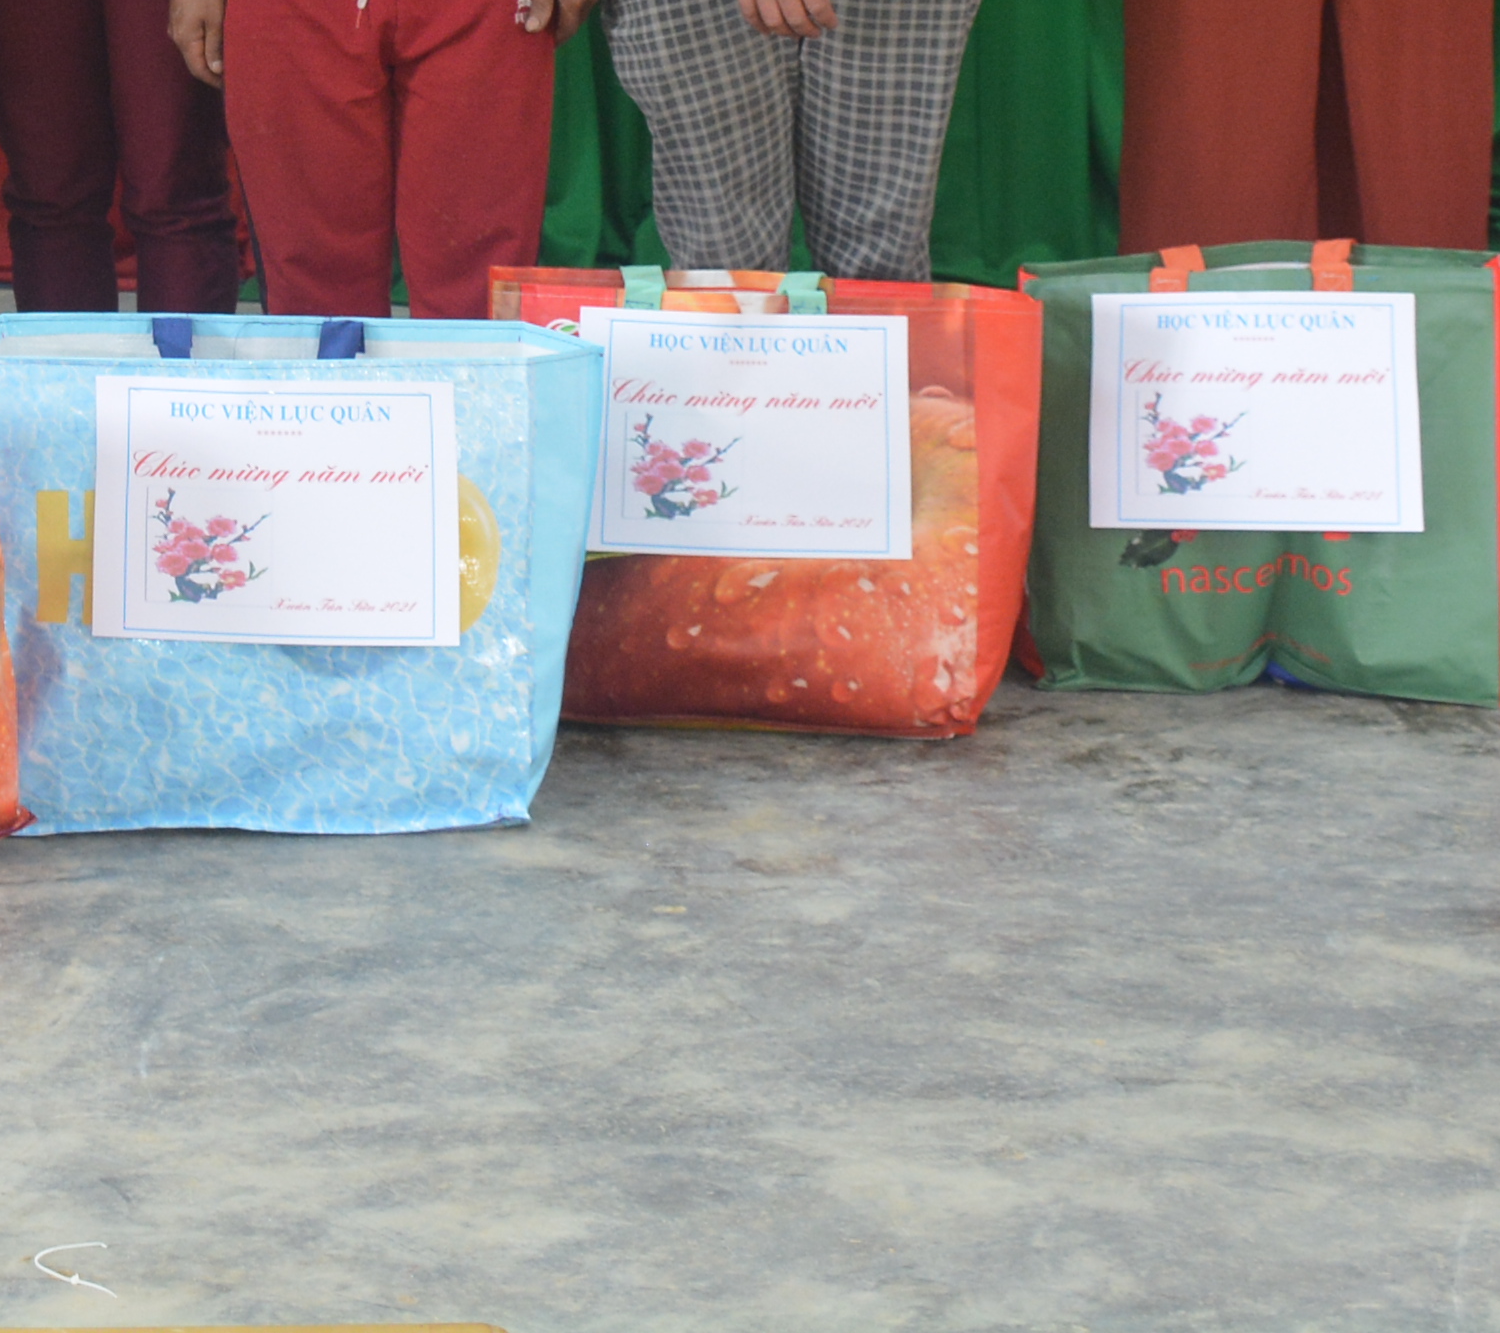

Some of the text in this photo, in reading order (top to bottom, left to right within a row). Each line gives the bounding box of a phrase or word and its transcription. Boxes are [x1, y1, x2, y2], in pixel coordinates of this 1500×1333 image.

[650, 334, 694, 351] HỌC
[700, 334, 744, 354] VIỆN
[170, 401, 391, 425] HỌC VIỆN LỤC QUÂN
[133, 451, 200, 479] Chúc
[298, 465, 360, 482] năm
[1161, 552, 1352, 596] nascemos
